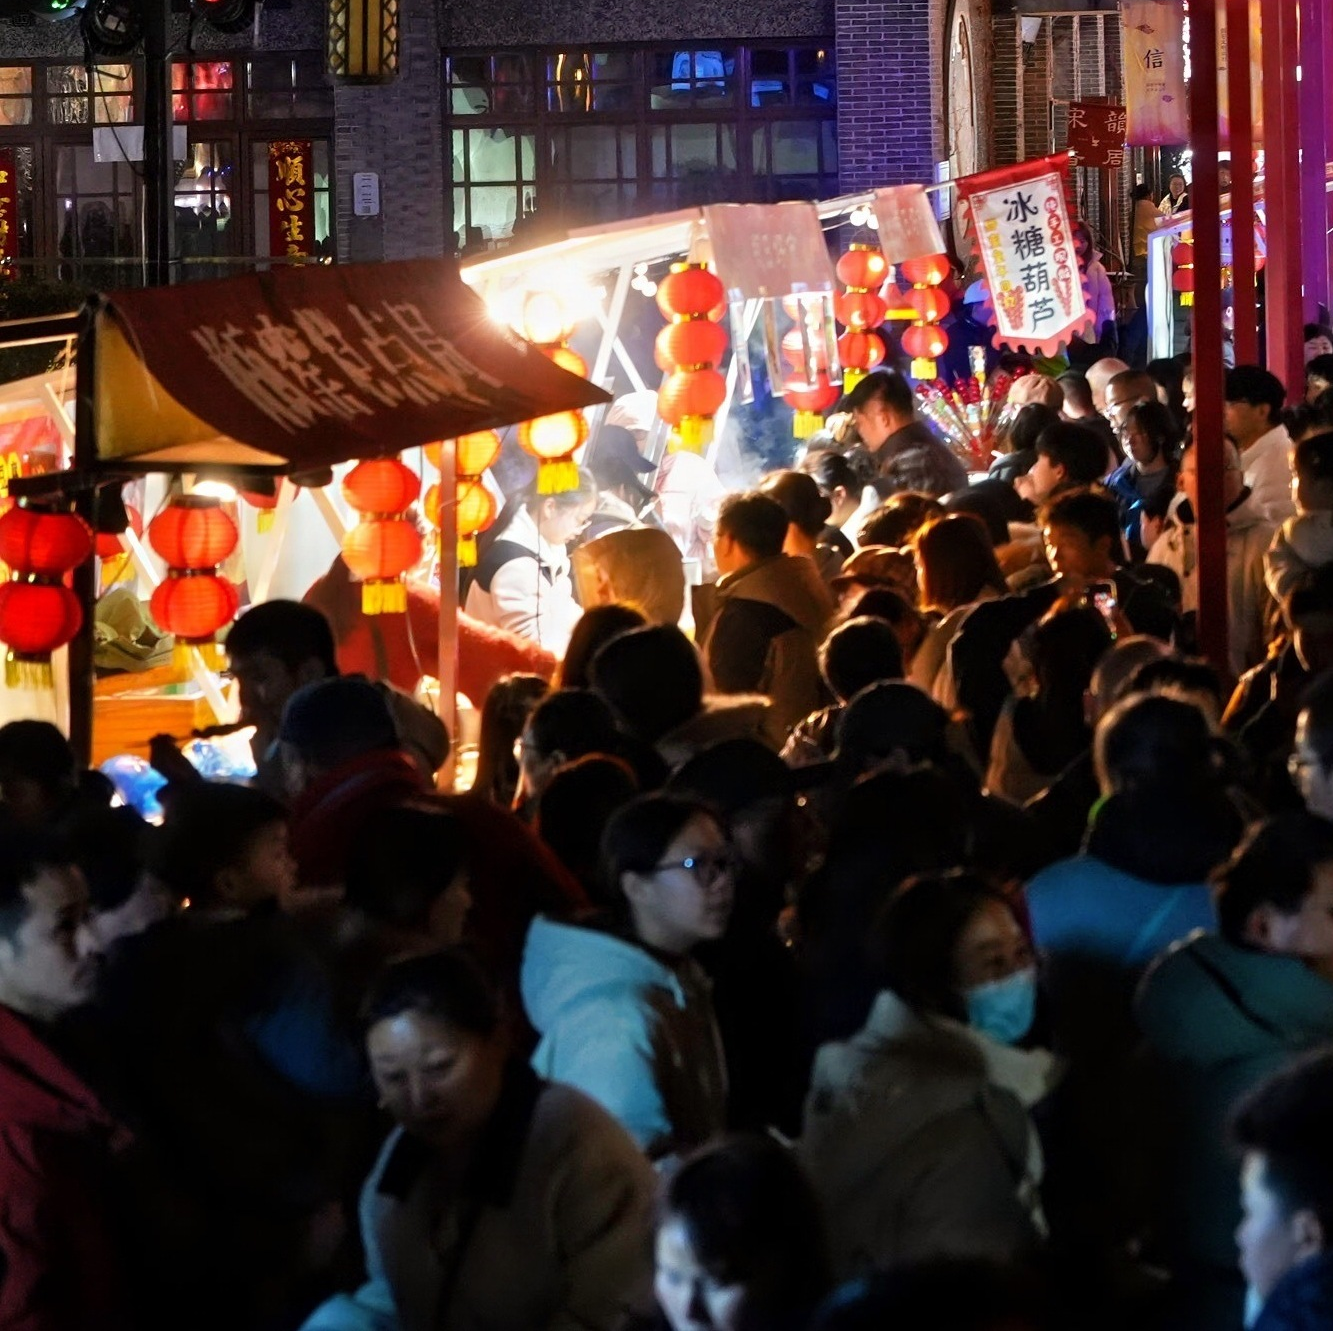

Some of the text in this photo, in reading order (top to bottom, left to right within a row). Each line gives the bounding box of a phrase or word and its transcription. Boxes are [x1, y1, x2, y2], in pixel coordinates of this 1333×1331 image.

[1143, 48, 1164, 69] 信
[1003, 191, 1055, 334] 冰糖葫芦
